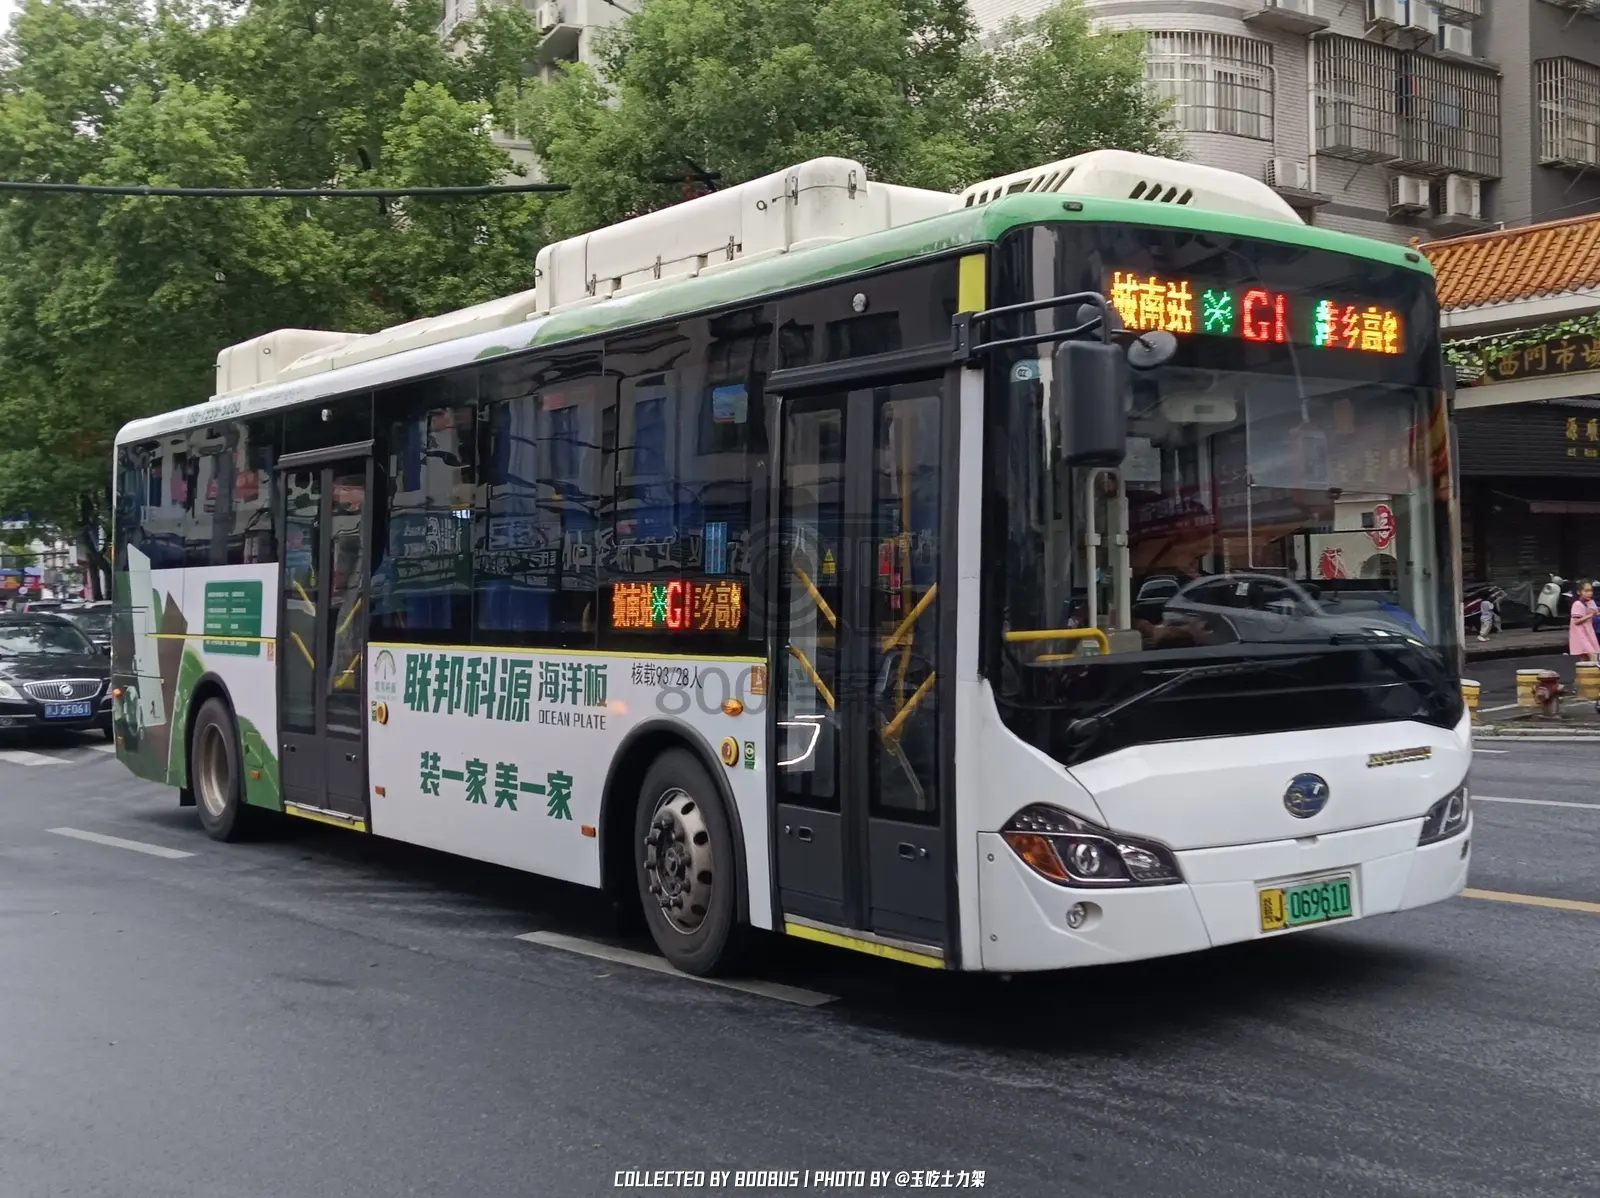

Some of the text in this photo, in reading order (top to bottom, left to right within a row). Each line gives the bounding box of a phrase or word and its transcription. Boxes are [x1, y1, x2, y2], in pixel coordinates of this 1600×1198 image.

[403, 653, 533, 722] 联邦科源
[538, 661, 608, 708] 海洋板
[631, 662, 703, 689] 核载93/28人
[538, 709, 607, 731] OCEAN PLATE
[420, 751, 574, 820] 装一家美一家
